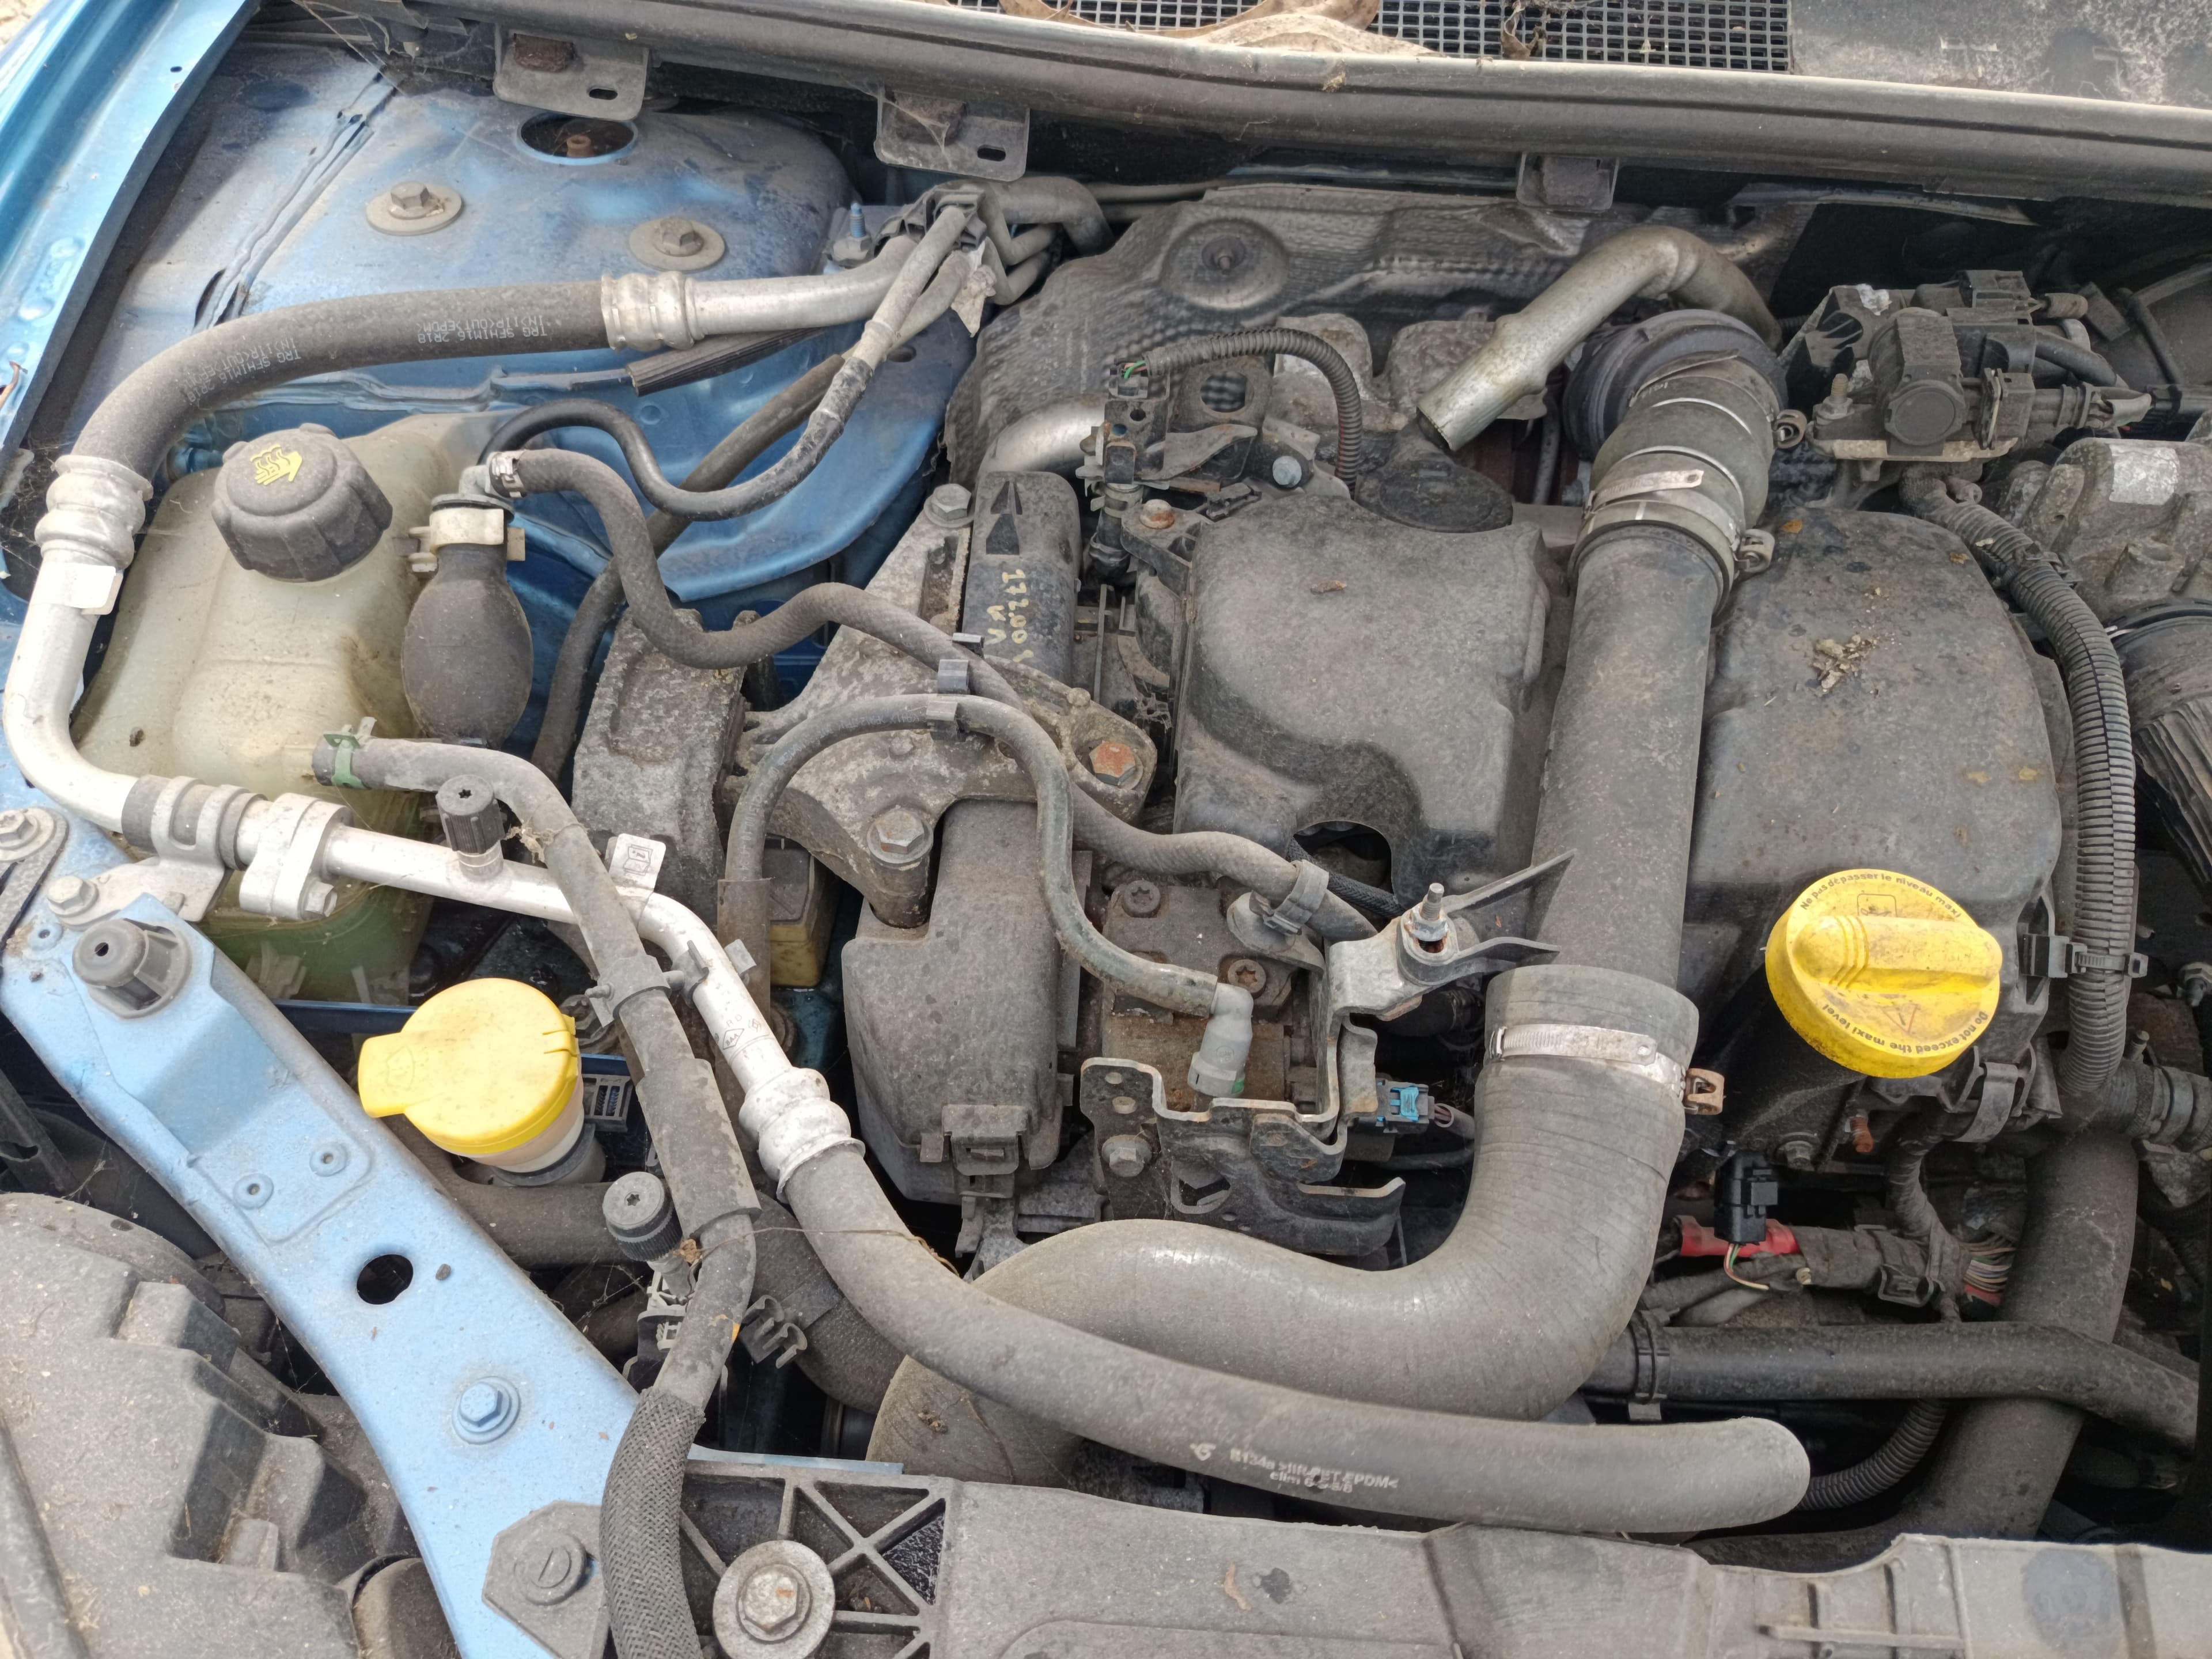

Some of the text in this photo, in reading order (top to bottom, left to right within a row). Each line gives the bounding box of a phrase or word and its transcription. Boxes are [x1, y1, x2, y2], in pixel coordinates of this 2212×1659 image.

[522, 326, 548, 337] TRG
[276, 349, 301, 363] TRG
[1800, 873, 1962, 918] Ne pas dépasser le niveau maxi
[1822, 1004, 1988, 1054] Do not exceed the maxi level
